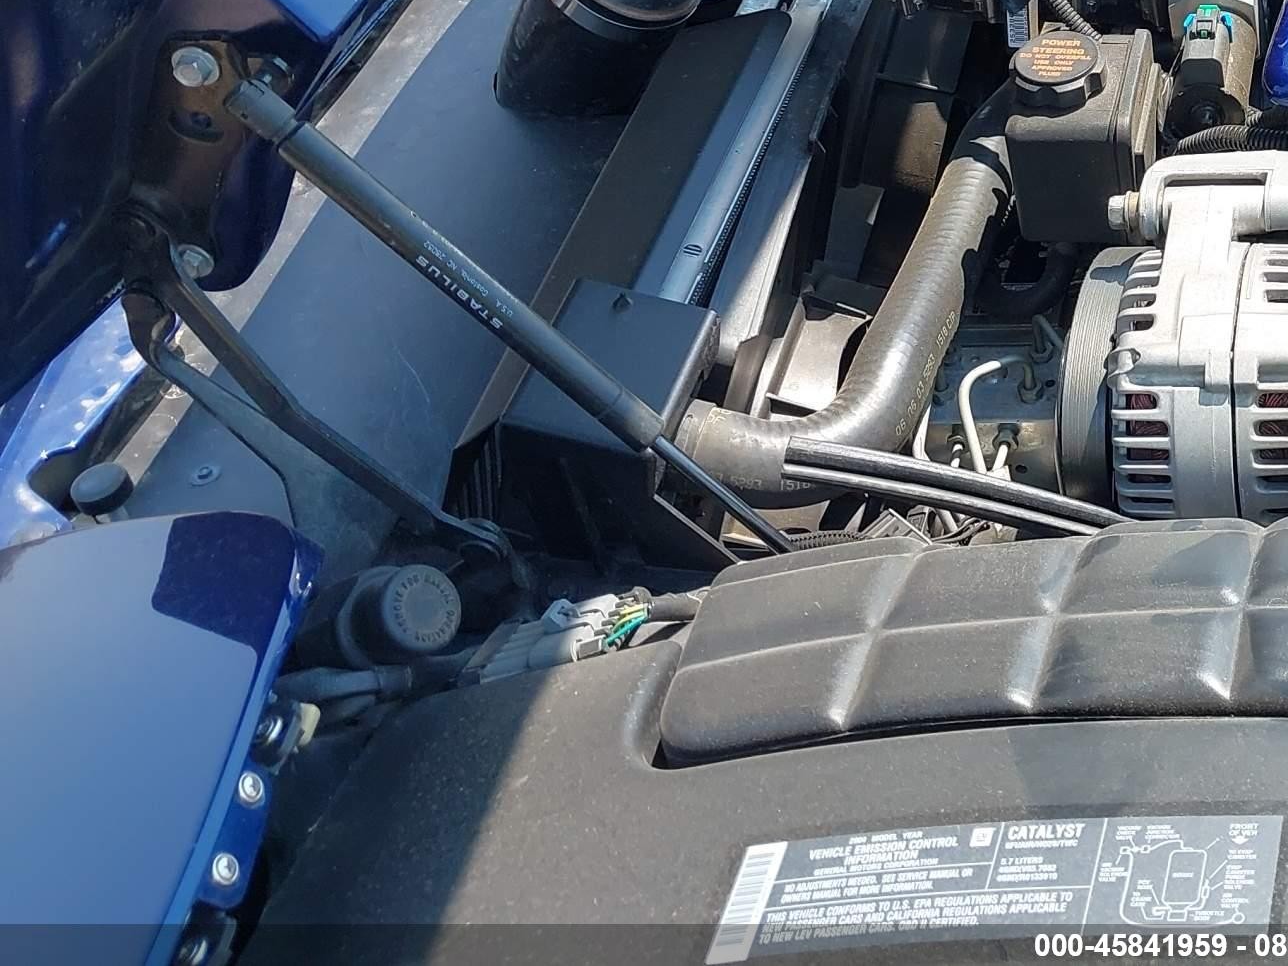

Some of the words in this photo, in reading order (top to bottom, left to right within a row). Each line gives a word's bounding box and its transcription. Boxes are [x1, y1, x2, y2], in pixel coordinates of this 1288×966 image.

[416, 255, 503, 329] STABILUS
[1008, 823, 1086, 840] CATALYST
[810, 846, 852, 860] VEHICLE
[854, 841, 906, 854] EMISSION
[908, 836, 959, 849] CONTROL
[844, 850, 919, 866] INFORMATION
[897, 870, 928, 882] SERVICE
[961, 868, 973, 877] OR
[767, 911, 787, 922] THIS
[789, 907, 825, 920] VEHICLE
[827, 902, 877, 915] CONFORMS
[879, 901, 891, 911] TO
[892, 899, 910, 910] U.S.
[914, 898, 931, 908] EPA
[934, 894, 999, 907] REGULATIONS
[1000, 892, 1057, 903] APPLICABLE
[1060, 891, 1073, 901] TO
[838, 913, 864, 925] CARS
[864, 911, 884, 923] AND
[886, 908, 940, 921] CALIFORNIA
[942, 904, 1007, 916] REGULATIONS
[1008, 902, 1067, 914] APPLICABLE
[759, 933, 771, 944] TO
[772, 931, 793, 942] NEW
[795, 928, 812, 941] LEV
[813, 924, 867, 939] PASSENGER
